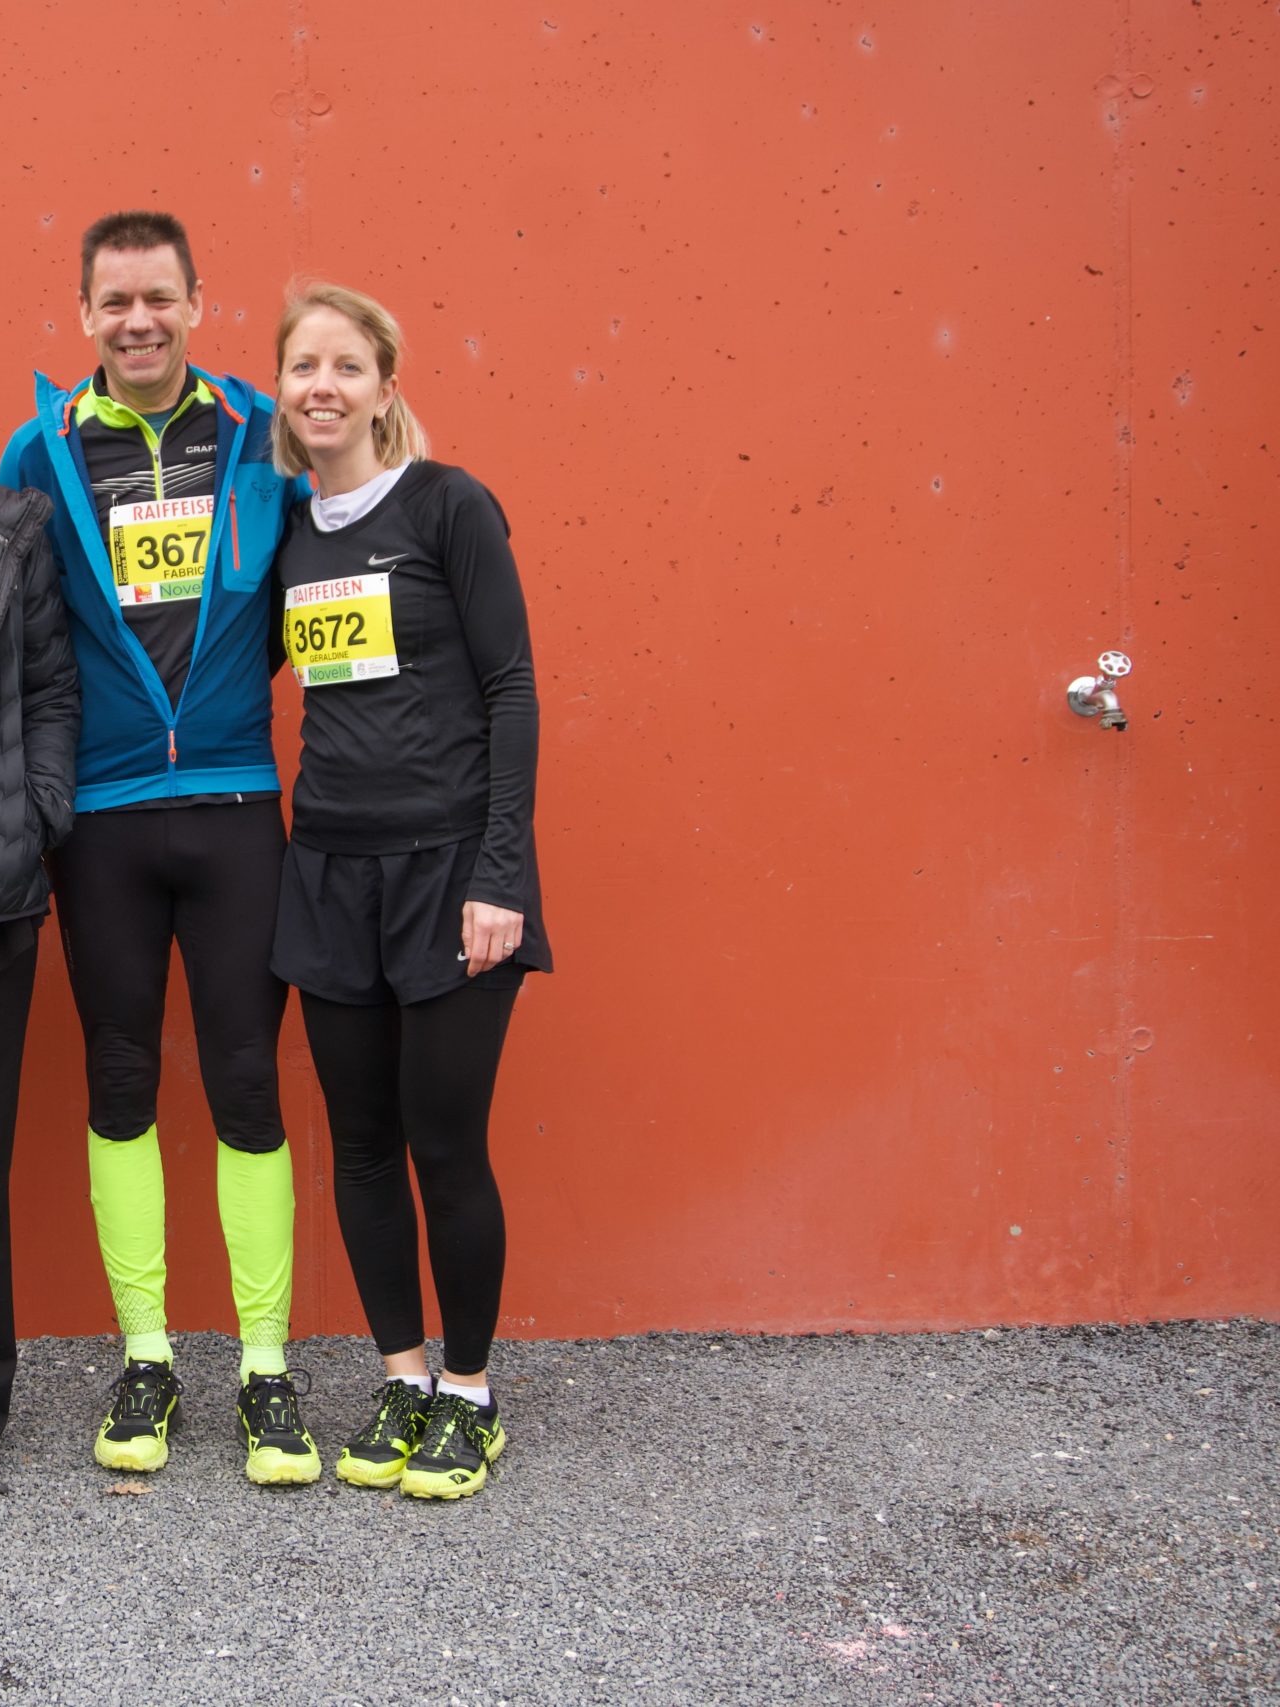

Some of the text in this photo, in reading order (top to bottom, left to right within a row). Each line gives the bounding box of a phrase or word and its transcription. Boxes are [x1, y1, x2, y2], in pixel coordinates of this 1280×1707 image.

[185, 444, 218, 454] CRAFT
[133, 499, 214, 521] RAIFFEISE
[136, 530, 206, 570] 367
[163, 566, 205, 579] FABRIC
[160, 580, 204, 597] Nove
[293, 579, 363, 603] RAIFFEISEN
[294, 611, 367, 653] 3672
[308, 663, 353, 682] Novelis
